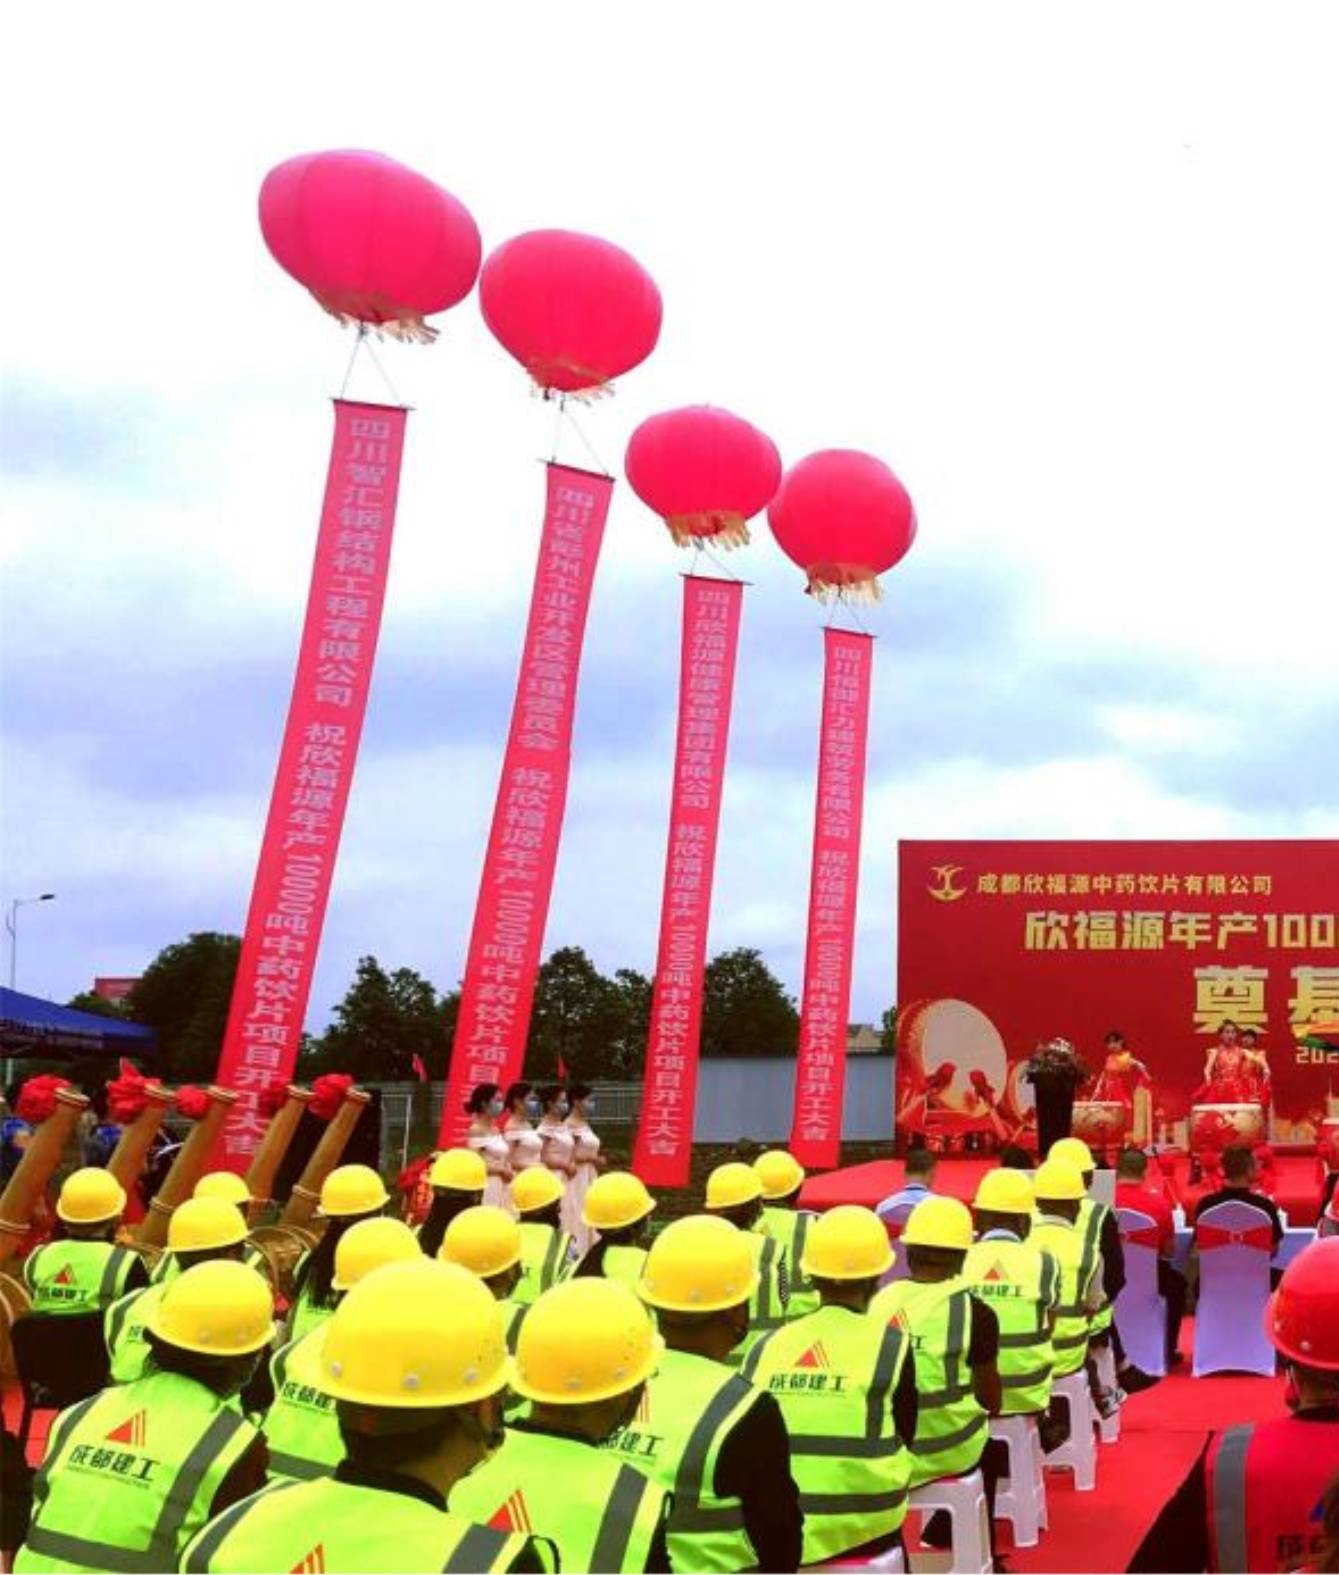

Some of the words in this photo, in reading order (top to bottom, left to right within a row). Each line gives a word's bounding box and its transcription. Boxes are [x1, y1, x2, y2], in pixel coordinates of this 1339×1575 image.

[313, 418, 391, 707] 四川智汇钢结构工程有限公司
[452, 768, 552, 1143] 祝欣福源年产10000吨中药饮片项目
[648, 824, 705, 1156] 祝欣福源年产10000吨中药饮片项目开工大吉
[800, 852, 848, 1141] 祝欣福源年产10000吨中药饮片项目开工大吉
[977, 873, 1272, 896] 成都欣福源中药饮片有限公司
[69, 1444, 161, 1483] 成都建工
[769, 1373, 848, 1392] 成都建工
